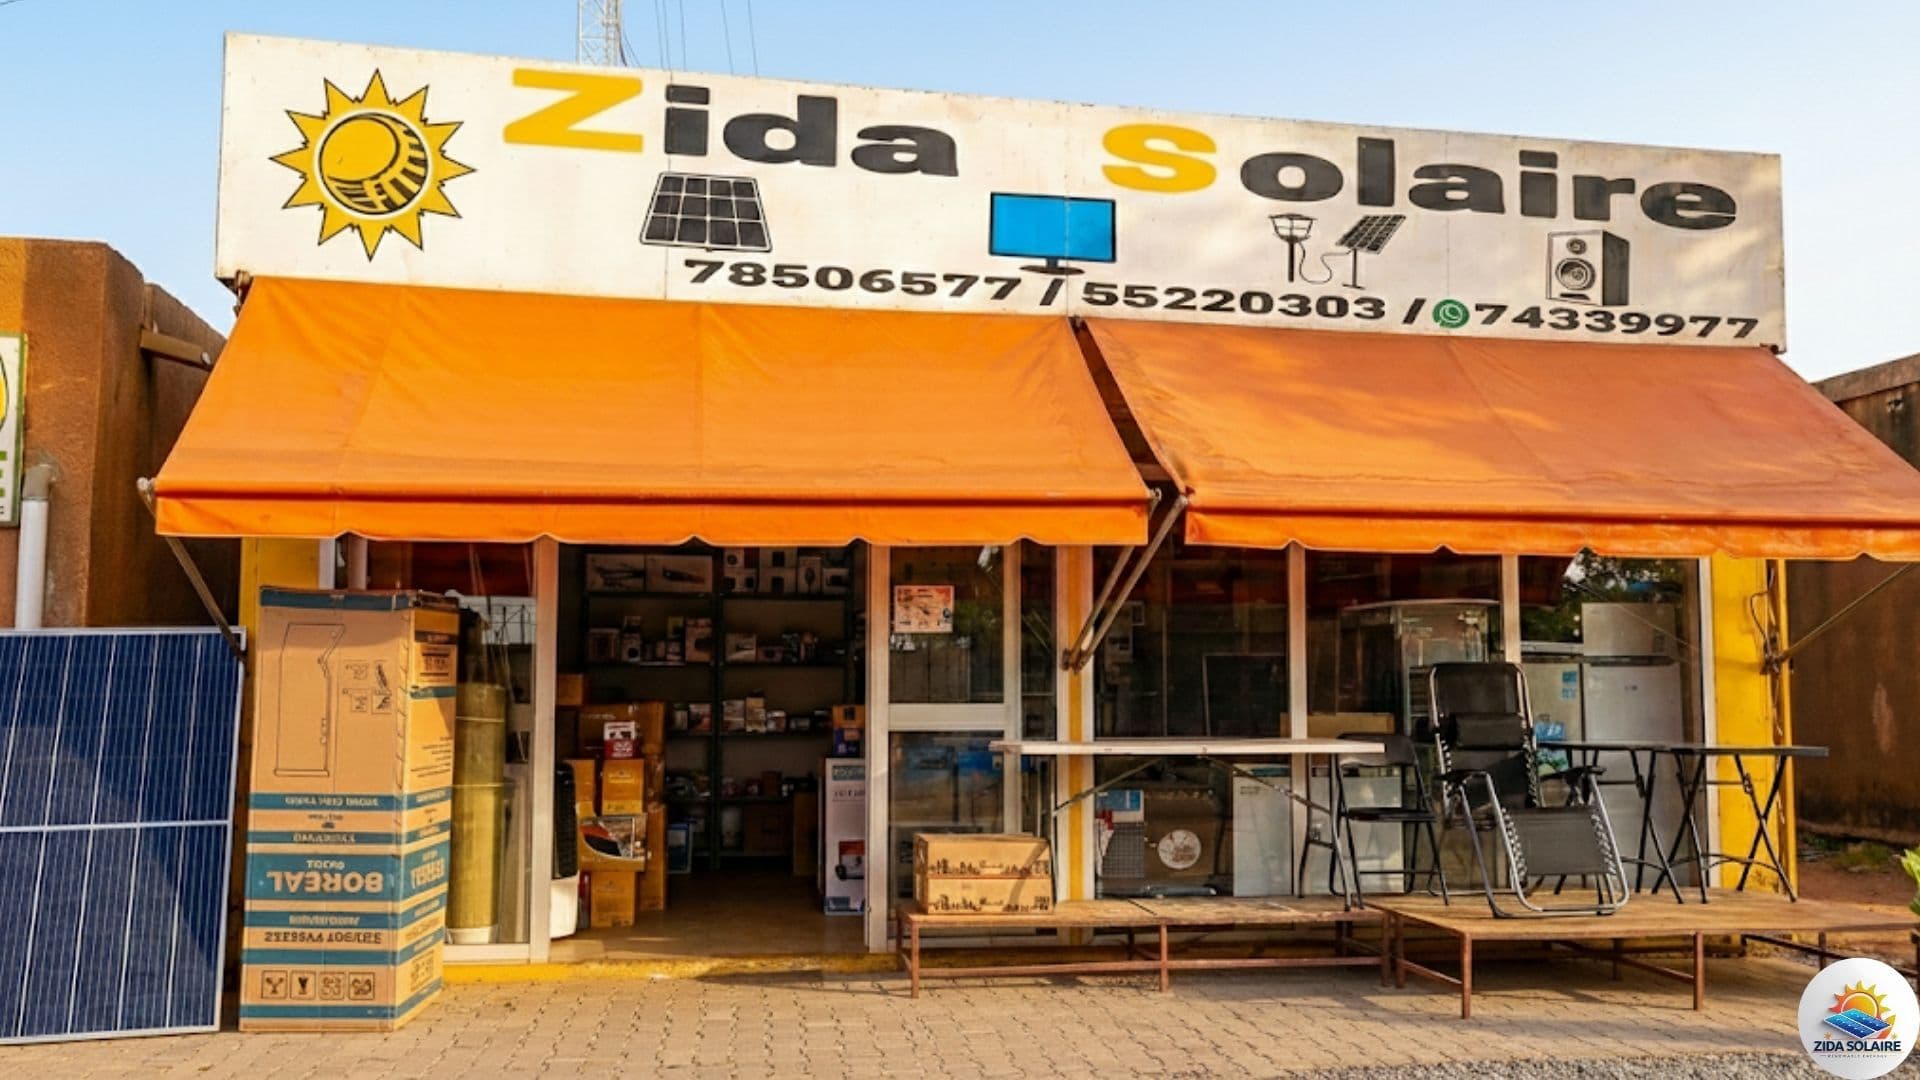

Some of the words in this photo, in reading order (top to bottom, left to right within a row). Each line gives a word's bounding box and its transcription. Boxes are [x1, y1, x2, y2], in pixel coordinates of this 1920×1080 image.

[503, 68, 958, 177] Zida
[1102, 123, 1738, 230] Solaire
[684, 259, 1022, 301] 78506577
[1039, 278, 1064, 306] /
[1081, 281, 1386, 320] 55220303
[1402, 298, 1426, 325] /
[1475, 303, 1759, 339] 74339977
[266, 871, 384, 893] BOREAL
